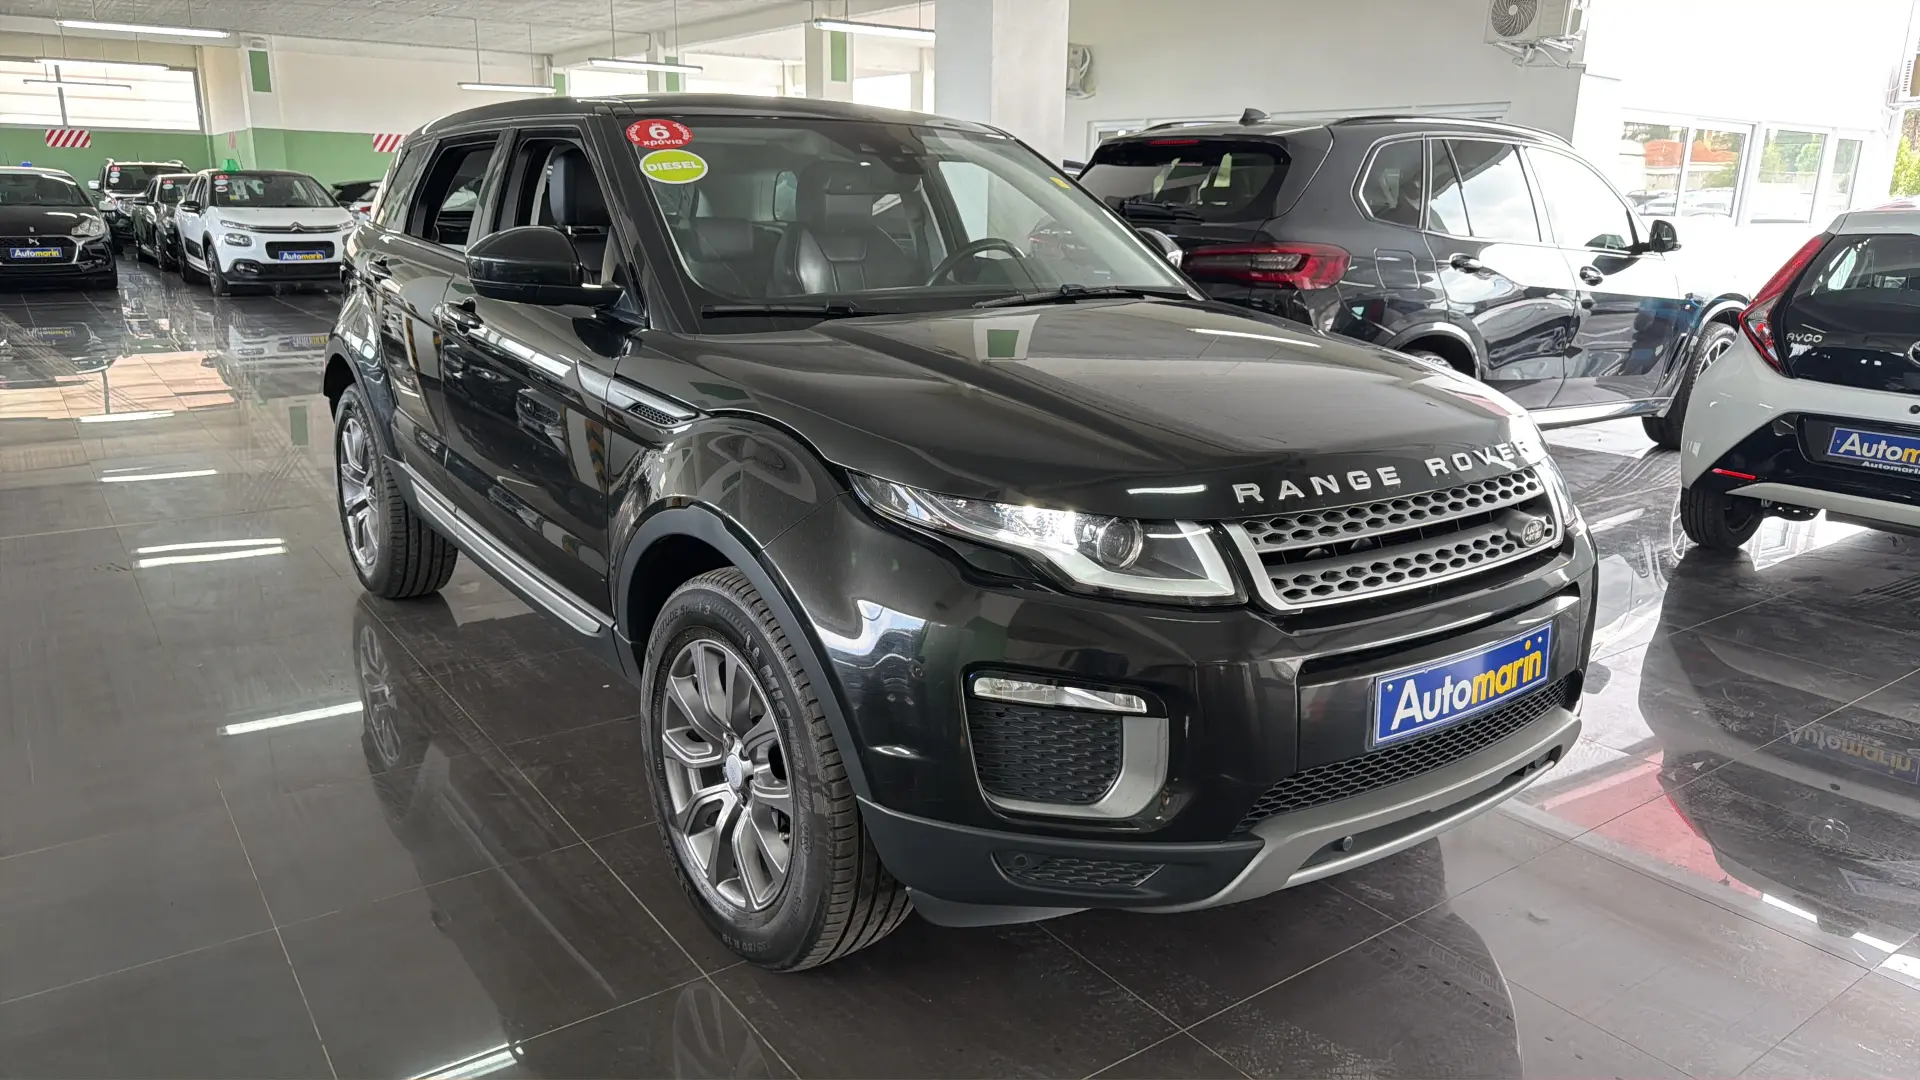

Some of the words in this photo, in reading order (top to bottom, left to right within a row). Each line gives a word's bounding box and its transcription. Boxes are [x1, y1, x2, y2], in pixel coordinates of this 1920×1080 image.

[649, 125, 670, 139] 6
[643, 139, 684, 147] χρόνια
[646, 160, 701, 172] DIESEL
[15, 249, 59, 257] Automarin
[1786, 332, 1823, 343] AYGO
[1232, 466, 1401, 503] RANGE
[1424, 440, 1532, 476] ROVER
[1862, 461, 1920, 474] Automari
[1390, 640, 1542, 730] Automarin
